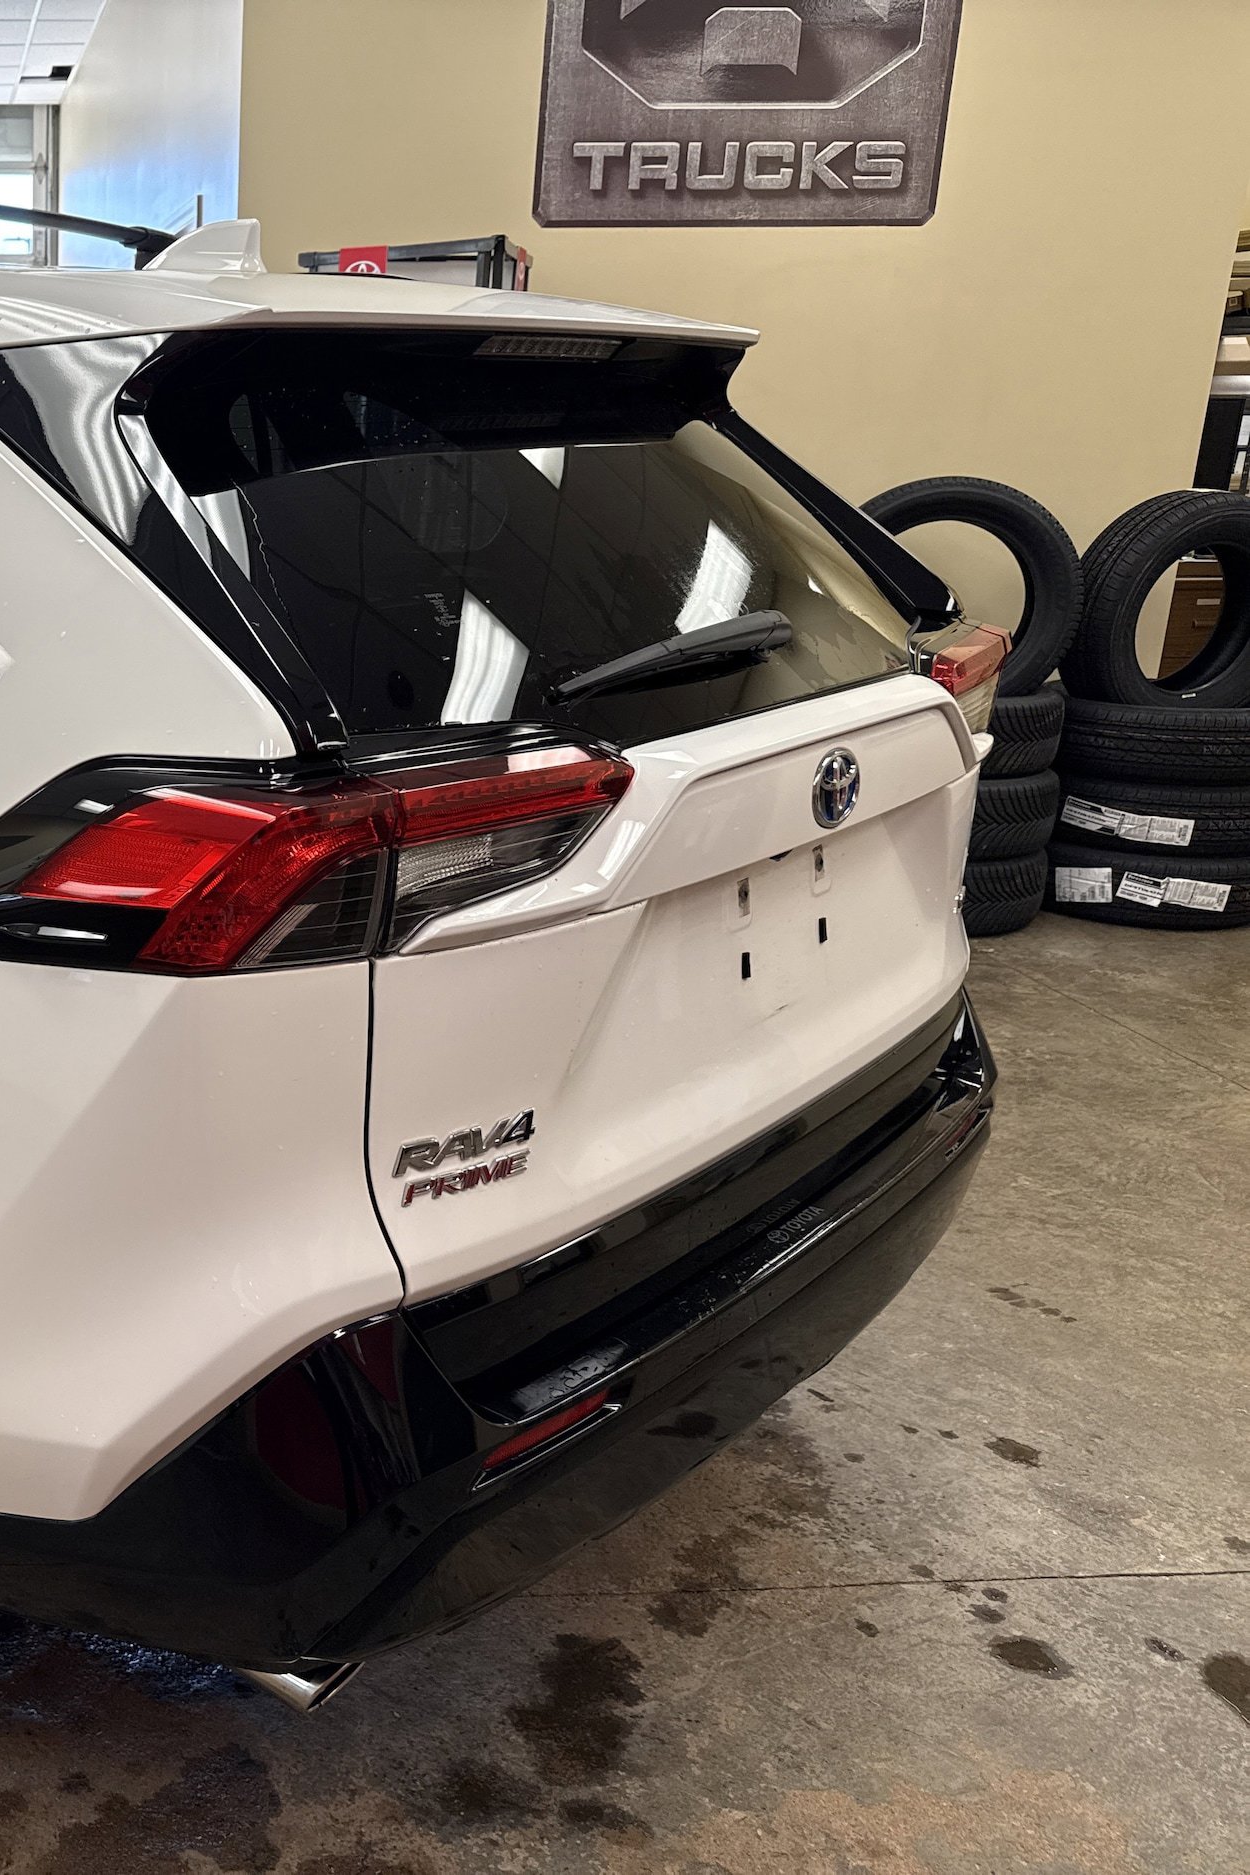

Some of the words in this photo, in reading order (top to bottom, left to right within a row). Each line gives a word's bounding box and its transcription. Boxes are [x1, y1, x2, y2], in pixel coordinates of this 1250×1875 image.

[572, 140, 907, 192] TRUCKS
[391, 1107, 536, 1178] RAV4
[401, 1148, 531, 1208] PRIME
[780, 1205, 825, 1233] TOYOTA
